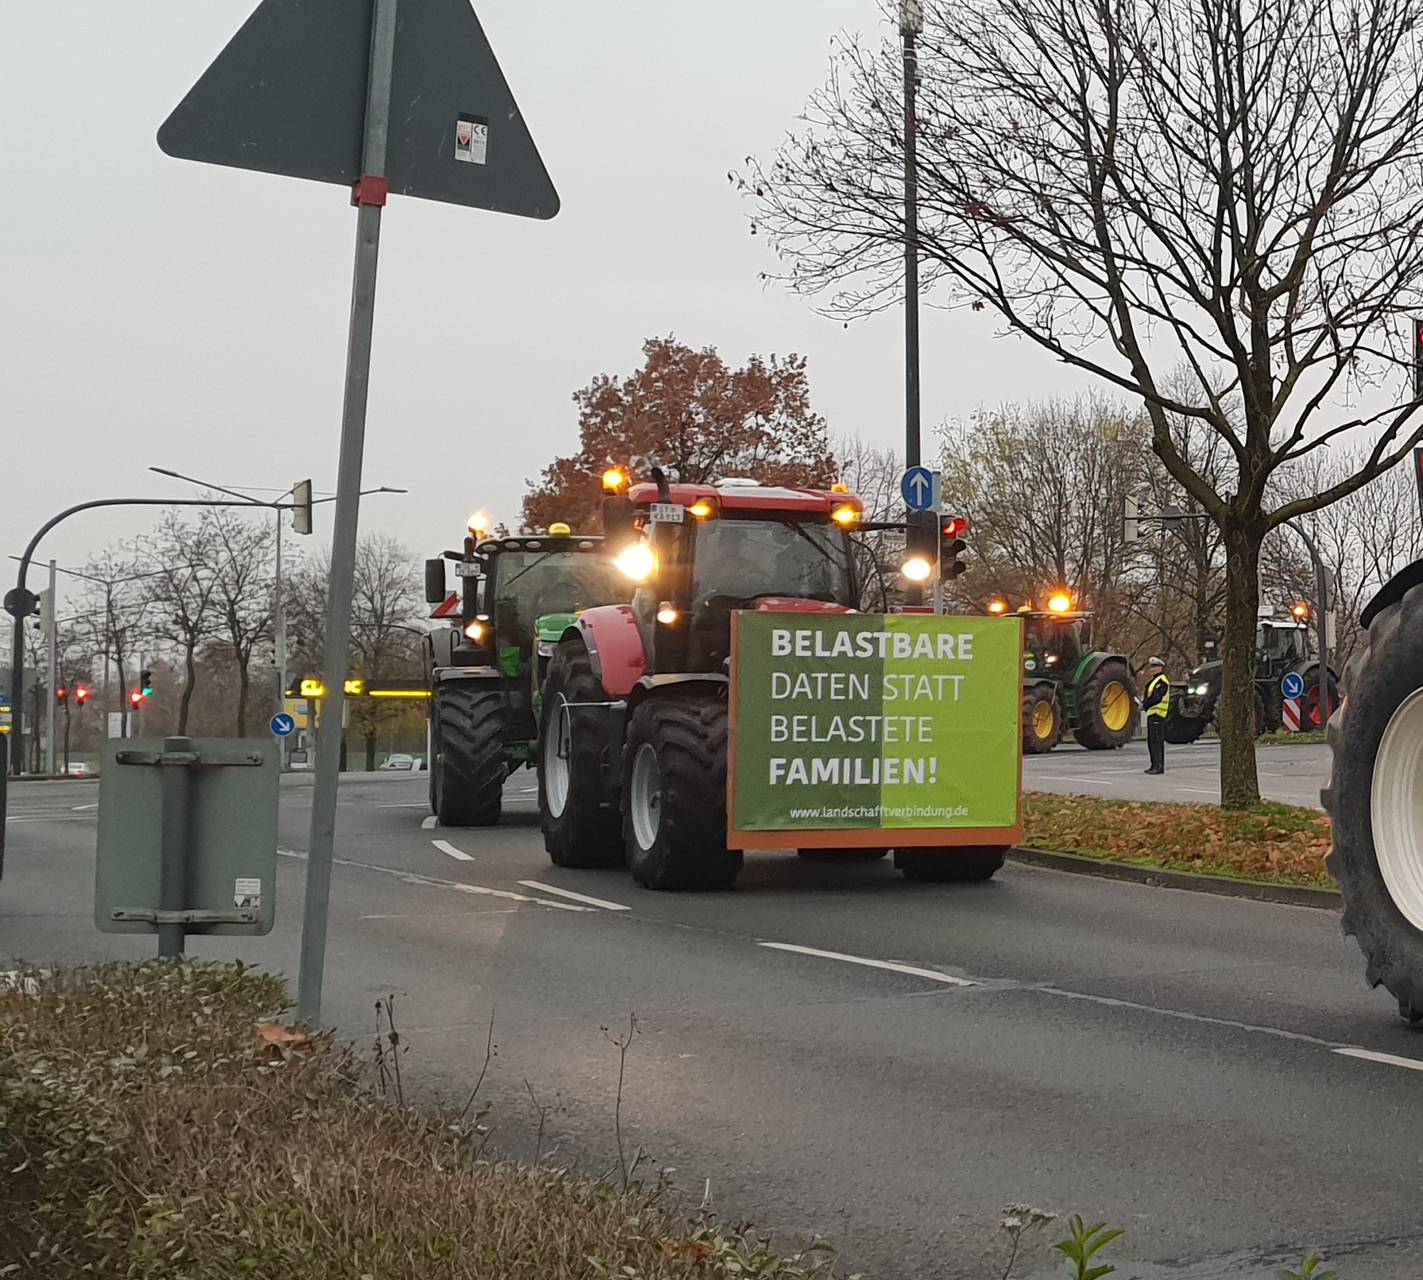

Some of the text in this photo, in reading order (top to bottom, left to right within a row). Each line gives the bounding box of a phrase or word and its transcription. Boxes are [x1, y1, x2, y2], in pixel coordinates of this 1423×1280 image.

[771, 629, 974, 660] BELASTBARE
[770, 672, 965, 701] DATEN STATT
[770, 714, 934, 743] BELASTETE
[769, 757, 938, 785] FAMILIEN!
[789, 805, 969, 819] www.landschafftverbindung.de
